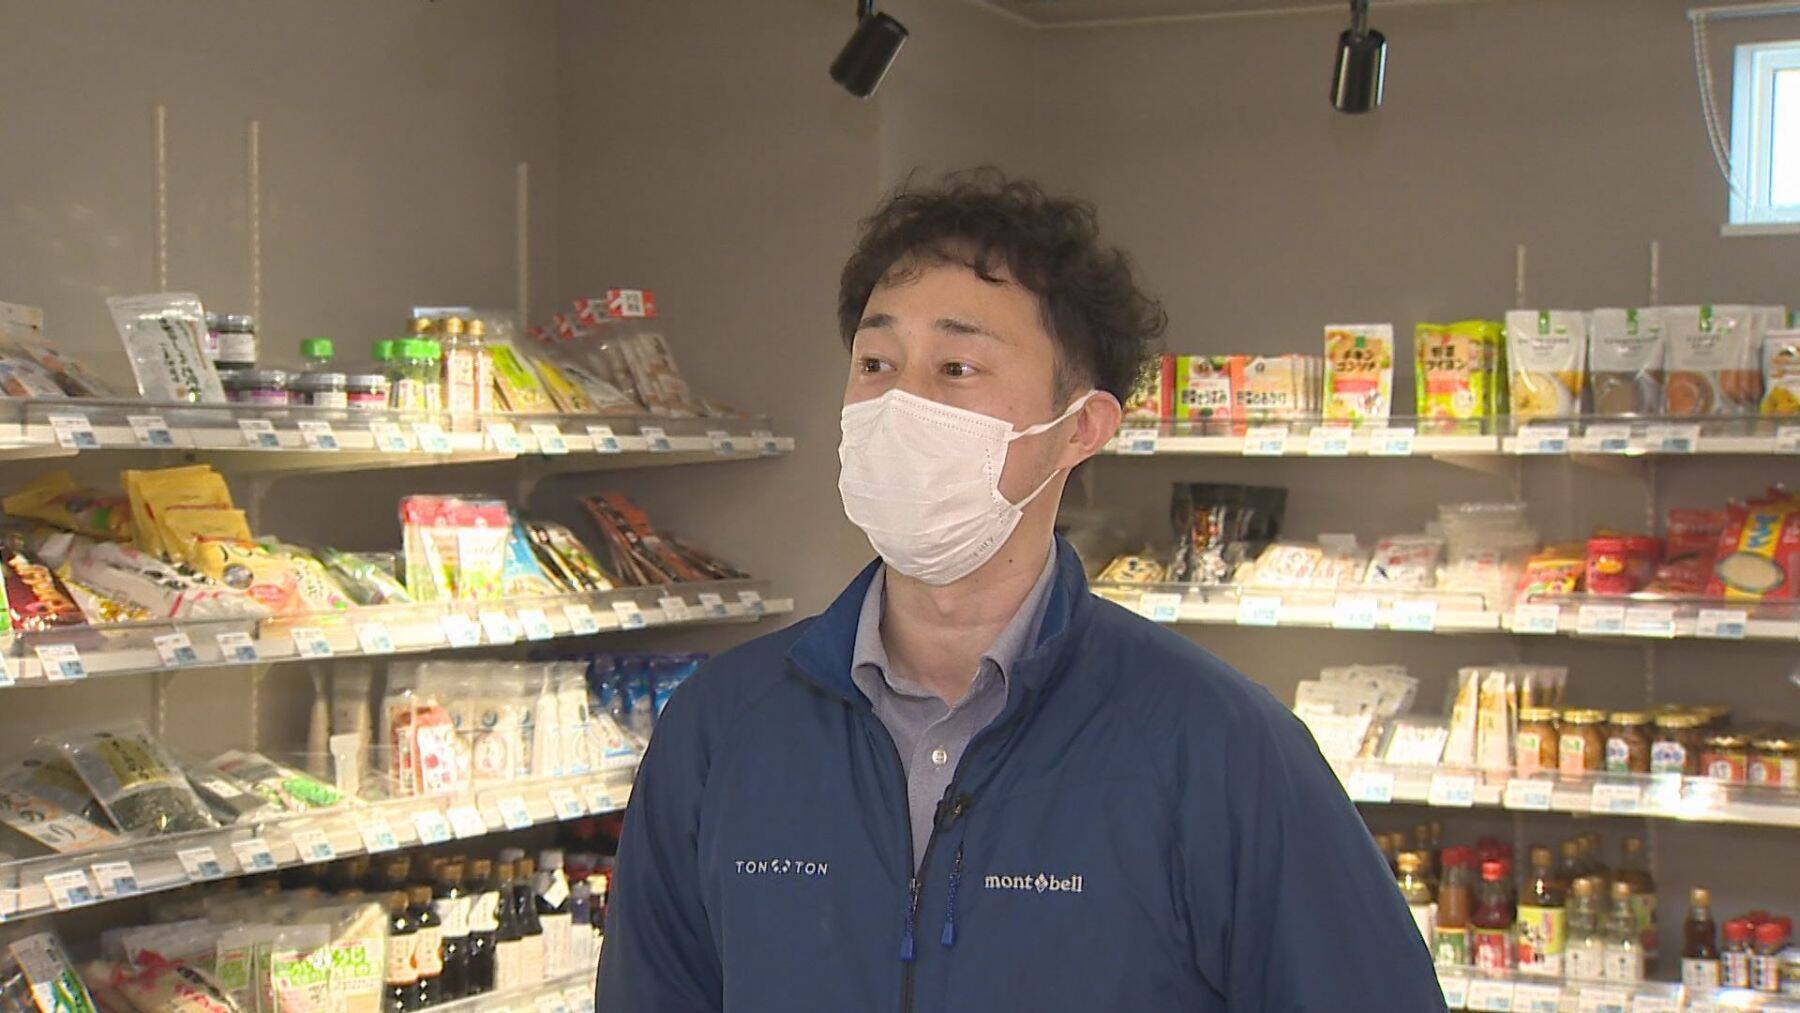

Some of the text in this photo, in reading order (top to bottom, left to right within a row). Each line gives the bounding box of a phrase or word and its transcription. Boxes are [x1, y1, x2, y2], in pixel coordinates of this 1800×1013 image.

[735, 861, 828, 875] TON TON
[984, 874, 1083, 892] mont bell
